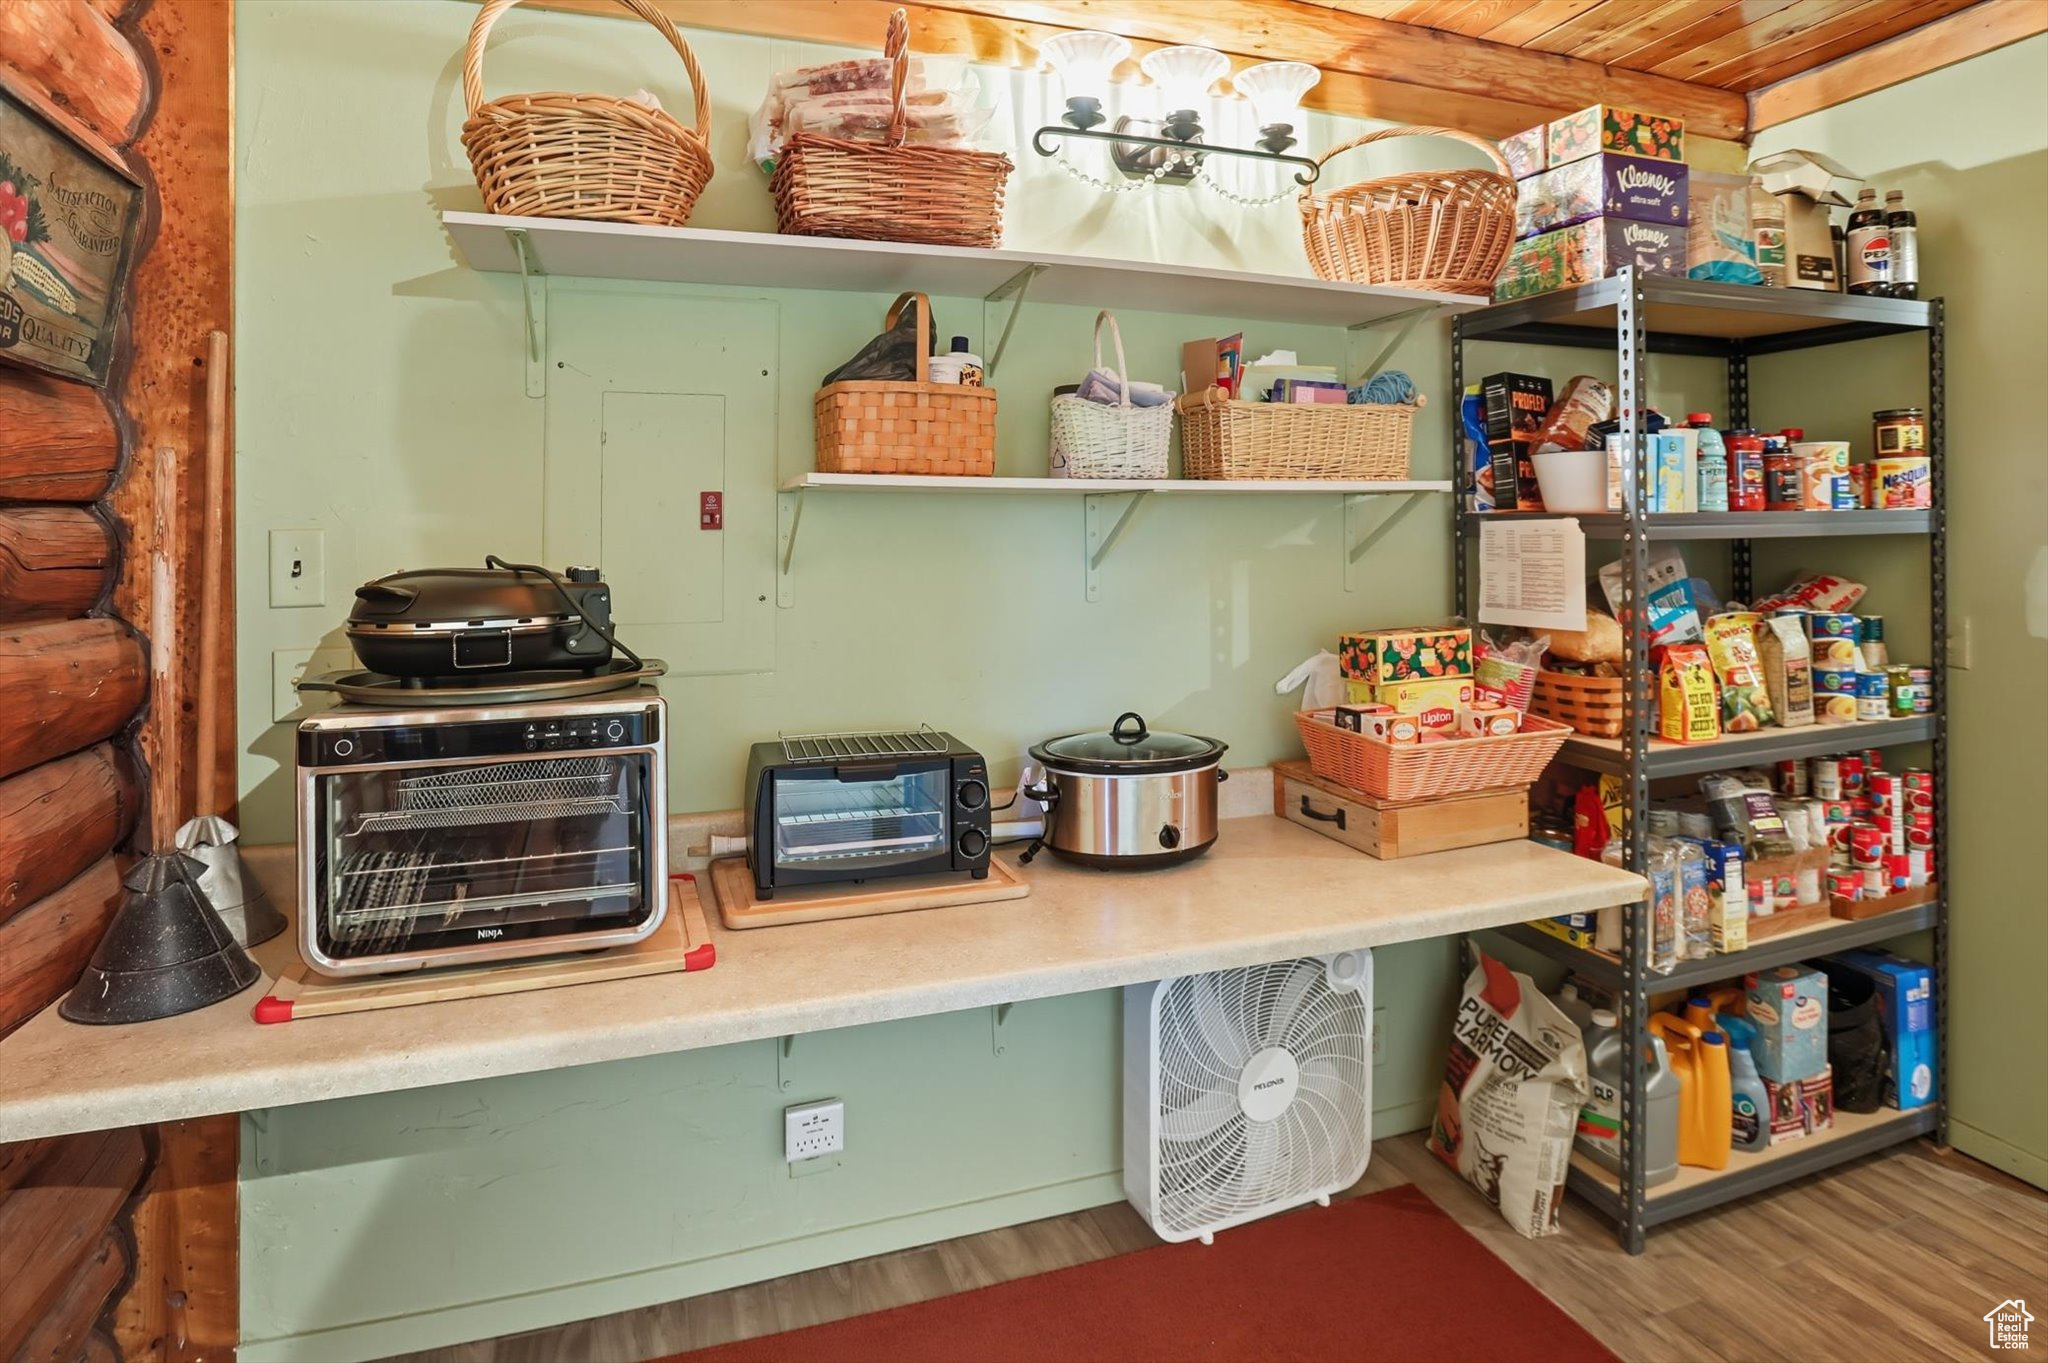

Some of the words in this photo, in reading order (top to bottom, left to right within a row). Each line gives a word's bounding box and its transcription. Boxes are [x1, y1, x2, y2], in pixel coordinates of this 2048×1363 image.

[46, 171, 117, 217] SATISFACTION
[1616, 164, 1676, 198] Kleenex
[68, 211, 120, 252] GUARANTEED
[1623, 223, 1670, 249] Kleenex
[23, 317, 88, 357] QUALITY
[714, 514, 720, 525] 1
[1421, 712, 1452, 726] Lipton
[477, 929, 504, 940] NINJA
[1460, 996, 1509, 1042] PURE
[1253, 1077, 1286, 1091] PELONIS
[1593, 1085, 1615, 1102] CLR
